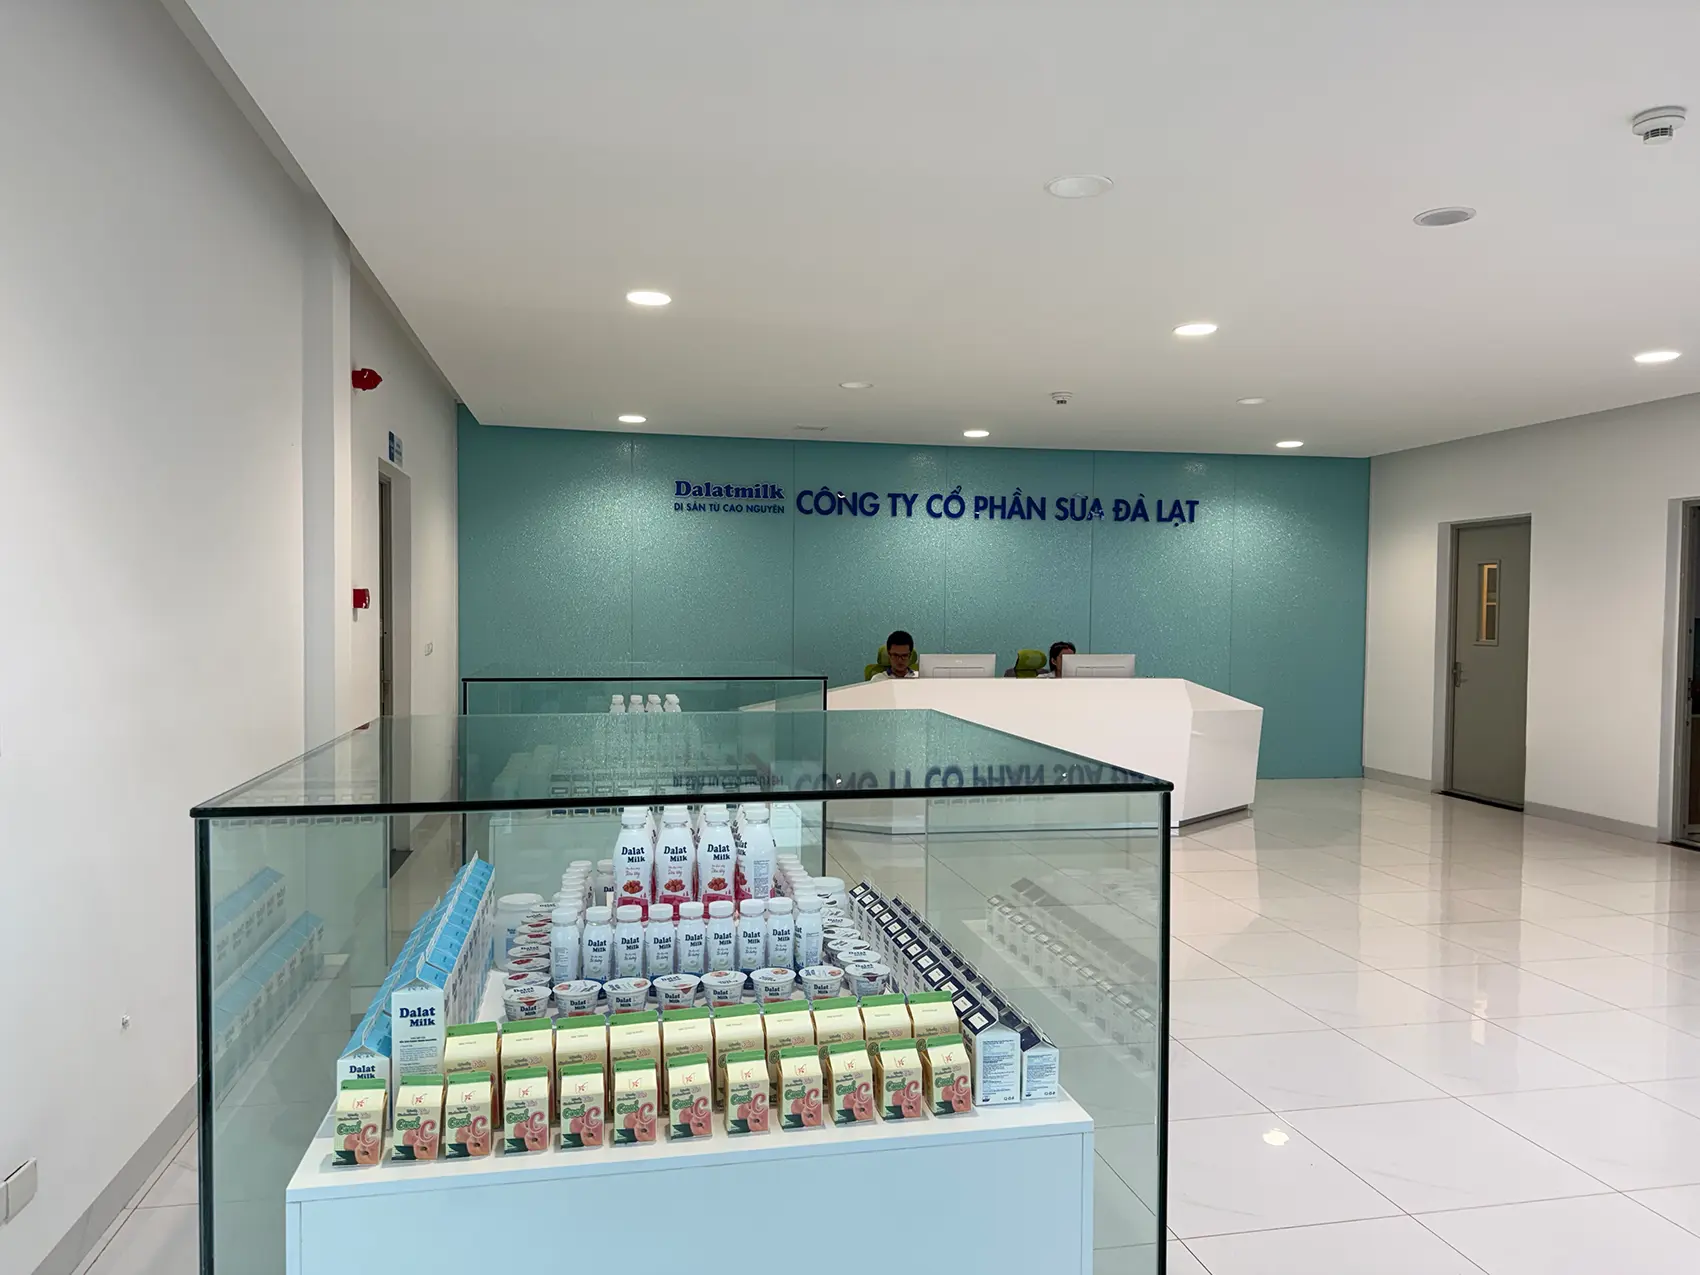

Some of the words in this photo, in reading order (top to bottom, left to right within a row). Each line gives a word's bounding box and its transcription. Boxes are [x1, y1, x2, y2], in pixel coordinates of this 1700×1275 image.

[674, 480, 785, 499] Dalatmilk
[674, 502, 683, 511] DI
[723, 504, 743, 512] CAO
[746, 503, 785, 513] NGUYÊN
[796, 486, 880, 517] CÔNG
[887, 493, 919, 517] TY
[926, 485, 966, 519] CỔ
[974, 487, 1046, 520] PHẦN
[1054, 492, 1104, 521] SỮA
[1112, 493, 1149, 522] ĐÀ
[1157, 499, 1200, 527] LẠT
[621, 846, 645, 856] Dalat
[664, 846, 687, 855] Dalat
[707, 844, 730, 853] Dalat
[653, 936, 671, 944] Dalat
[685, 933, 703, 941] Dalat
[714, 932, 732, 940] Dalat
[399, 1006, 436, 1018] Dalat
[409, 1018, 436, 1028] Milk
[349, 1065, 376, 1073] Dalat
[856, 1082, 870, 1103] C
[905, 1080, 920, 1101] C
[954, 1076, 968, 1096] C
[693, 1096, 708, 1118] C
[751, 1092, 766, 1114] C
[805, 1088, 819, 1108] C
[528, 1112, 545, 1133] C
[584, 1106, 601, 1128] C
[638, 1102, 653, 1124] C
[360, 1123, 377, 1146] C
[419, 1119, 436, 1142] C
[471, 1116, 487, 1138] C
